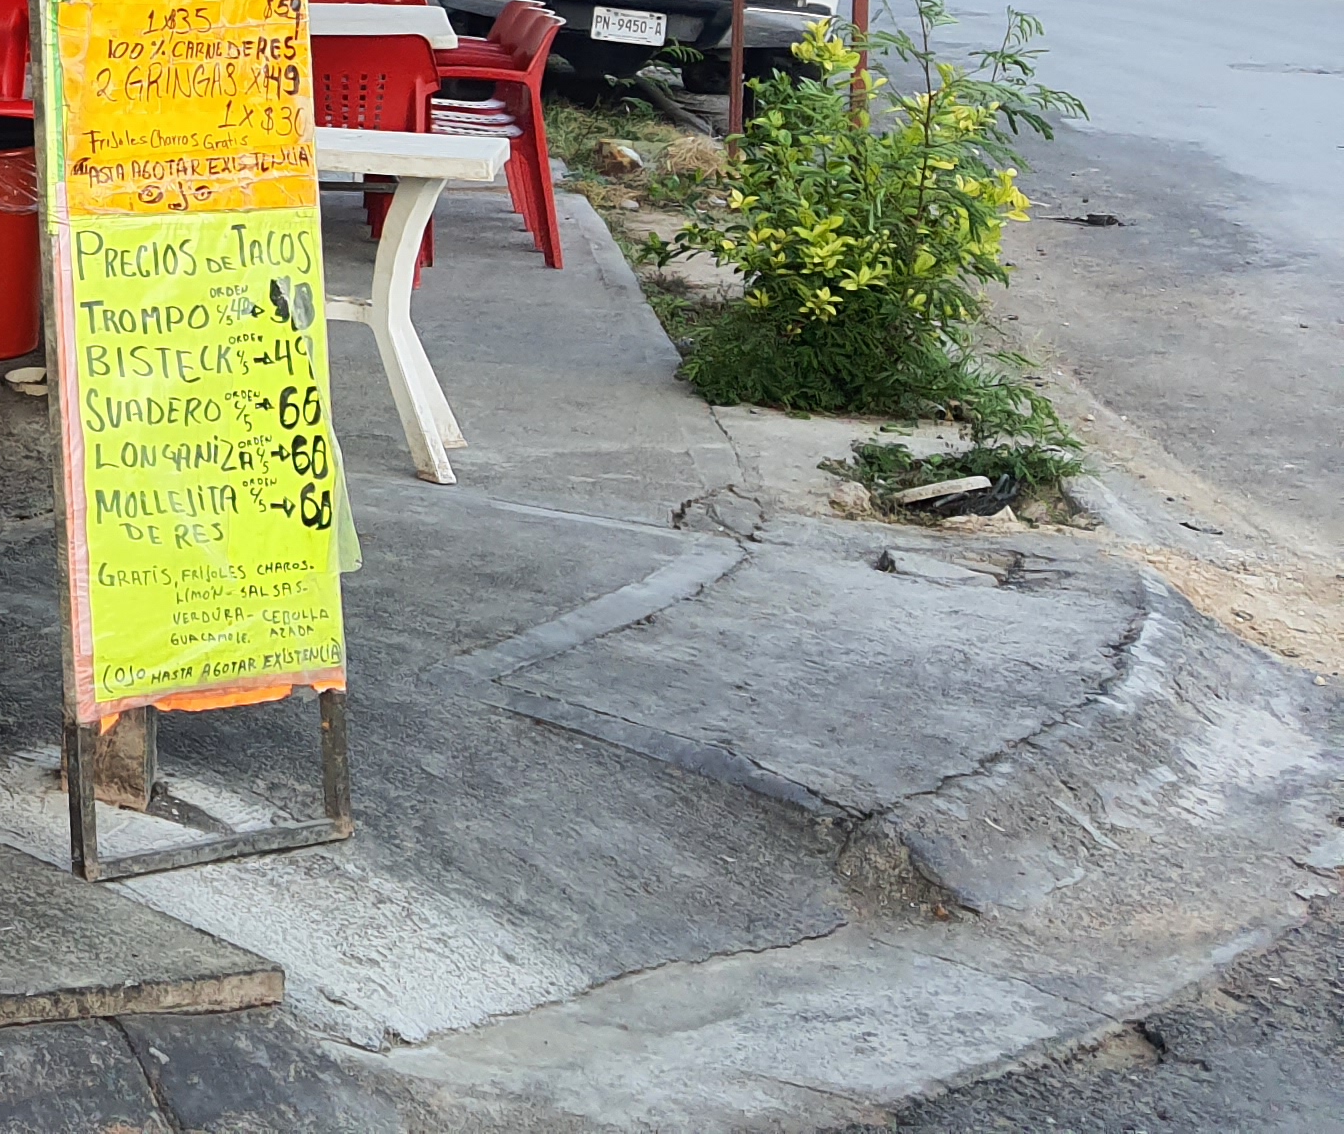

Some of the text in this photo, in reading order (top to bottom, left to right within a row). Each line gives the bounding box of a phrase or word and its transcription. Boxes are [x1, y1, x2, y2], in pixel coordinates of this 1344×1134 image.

[595, 15, 662, 36] PN-9450-A
[96, 68, 117, 101] 2
[125, 62, 237, 102] GRINGAS
[203, 132, 248, 150] Gratis
[131, 158, 204, 181] AGOTAR
[76, 224, 311, 280] PRECIOS DE TACOS
[81, 300, 209, 335] TROMPO
[210, 285, 248, 298] ORDEN
[86, 345, 233, 383] BISTECK
[229, 333, 263, 344] ORDEN
[86, 388, 221, 432] SUADERO
[225, 389, 260, 402] ORDEN
[238, 435, 272, 449] ORDEN
[242, 477, 277, 487] ORDEN
[120, 522, 223, 549] DE RES
[181, 565, 246, 583] FRIJOLES
[262, 608, 329, 624] CEBOLLA
[151, 667, 192, 684] HASTA
[202, 657, 257, 677] AGOTAR
